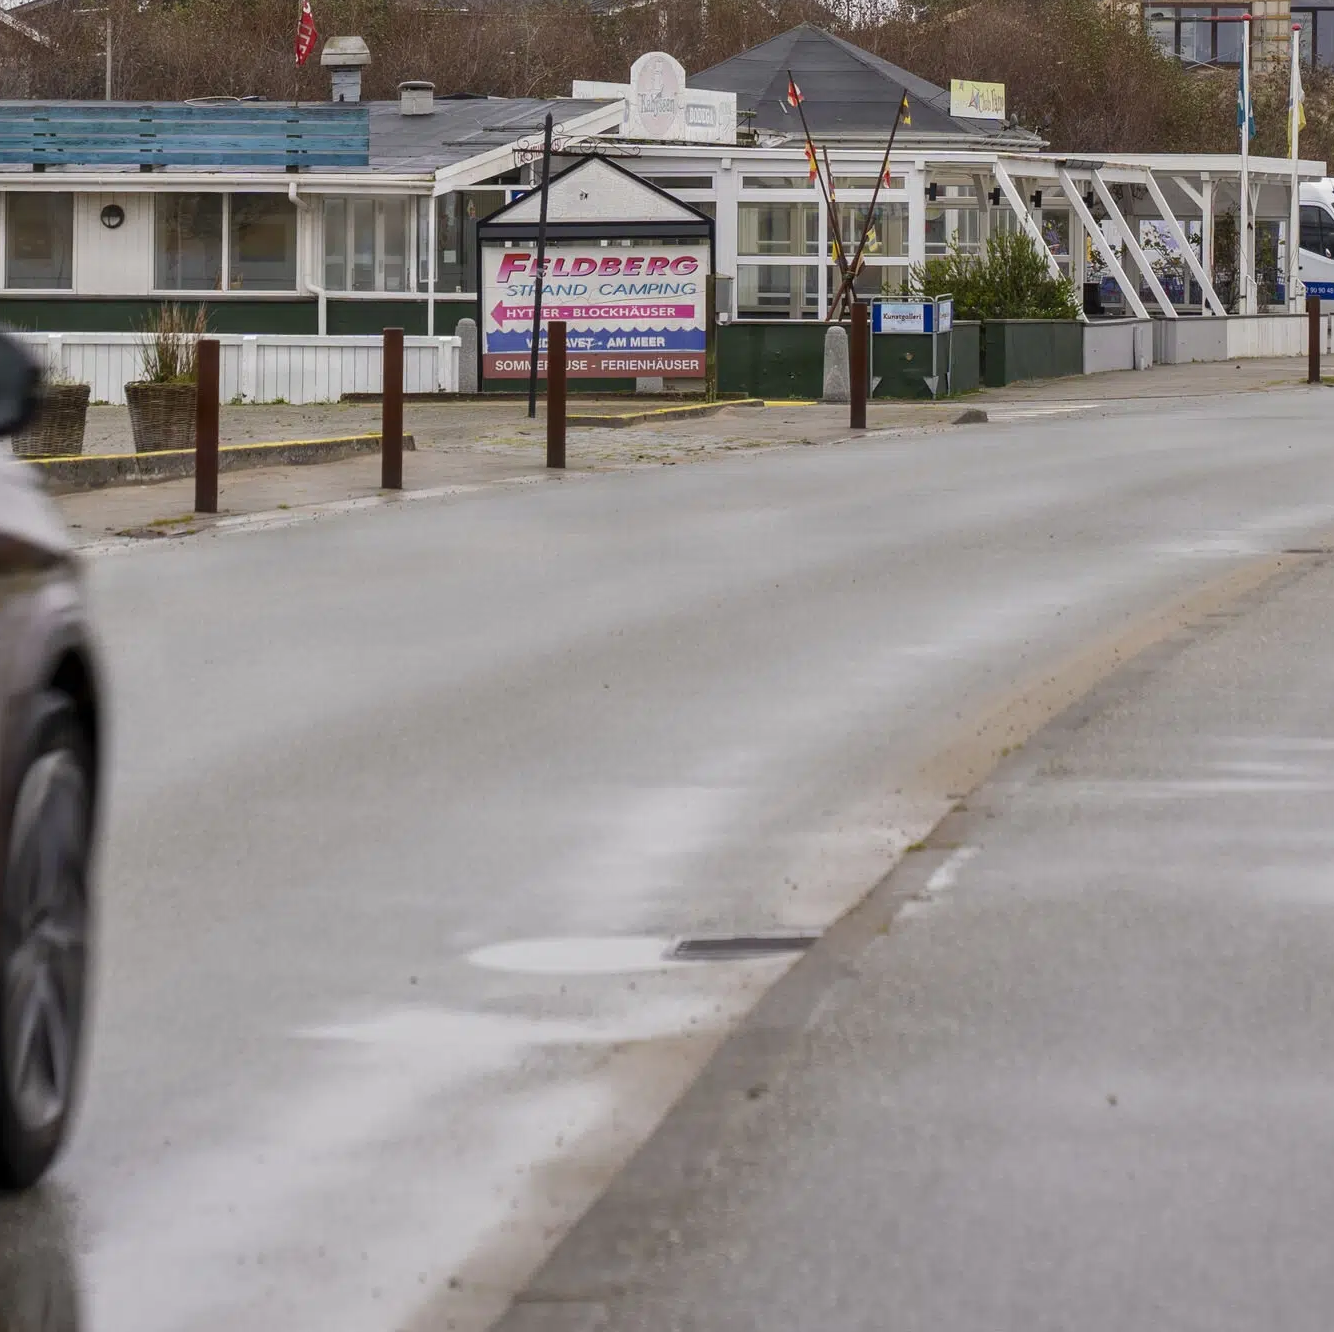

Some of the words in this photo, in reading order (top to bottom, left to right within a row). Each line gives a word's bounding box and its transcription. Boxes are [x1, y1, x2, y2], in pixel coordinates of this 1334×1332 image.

[496, 253, 699, 283] FELDBERG
[599, 282, 697, 295] CAMPING
[507, 308, 559, 317] HYTER
[573, 306, 675, 317] BLOCKHÄUSER
[566, 338, 595, 349] AVET
[607, 337, 626, 348] AM
[630, 337, 665, 347] MEER
[495, 360, 588, 370] SOMMEUSE
[601, 357, 699, 370] FERIENHÄUSER
